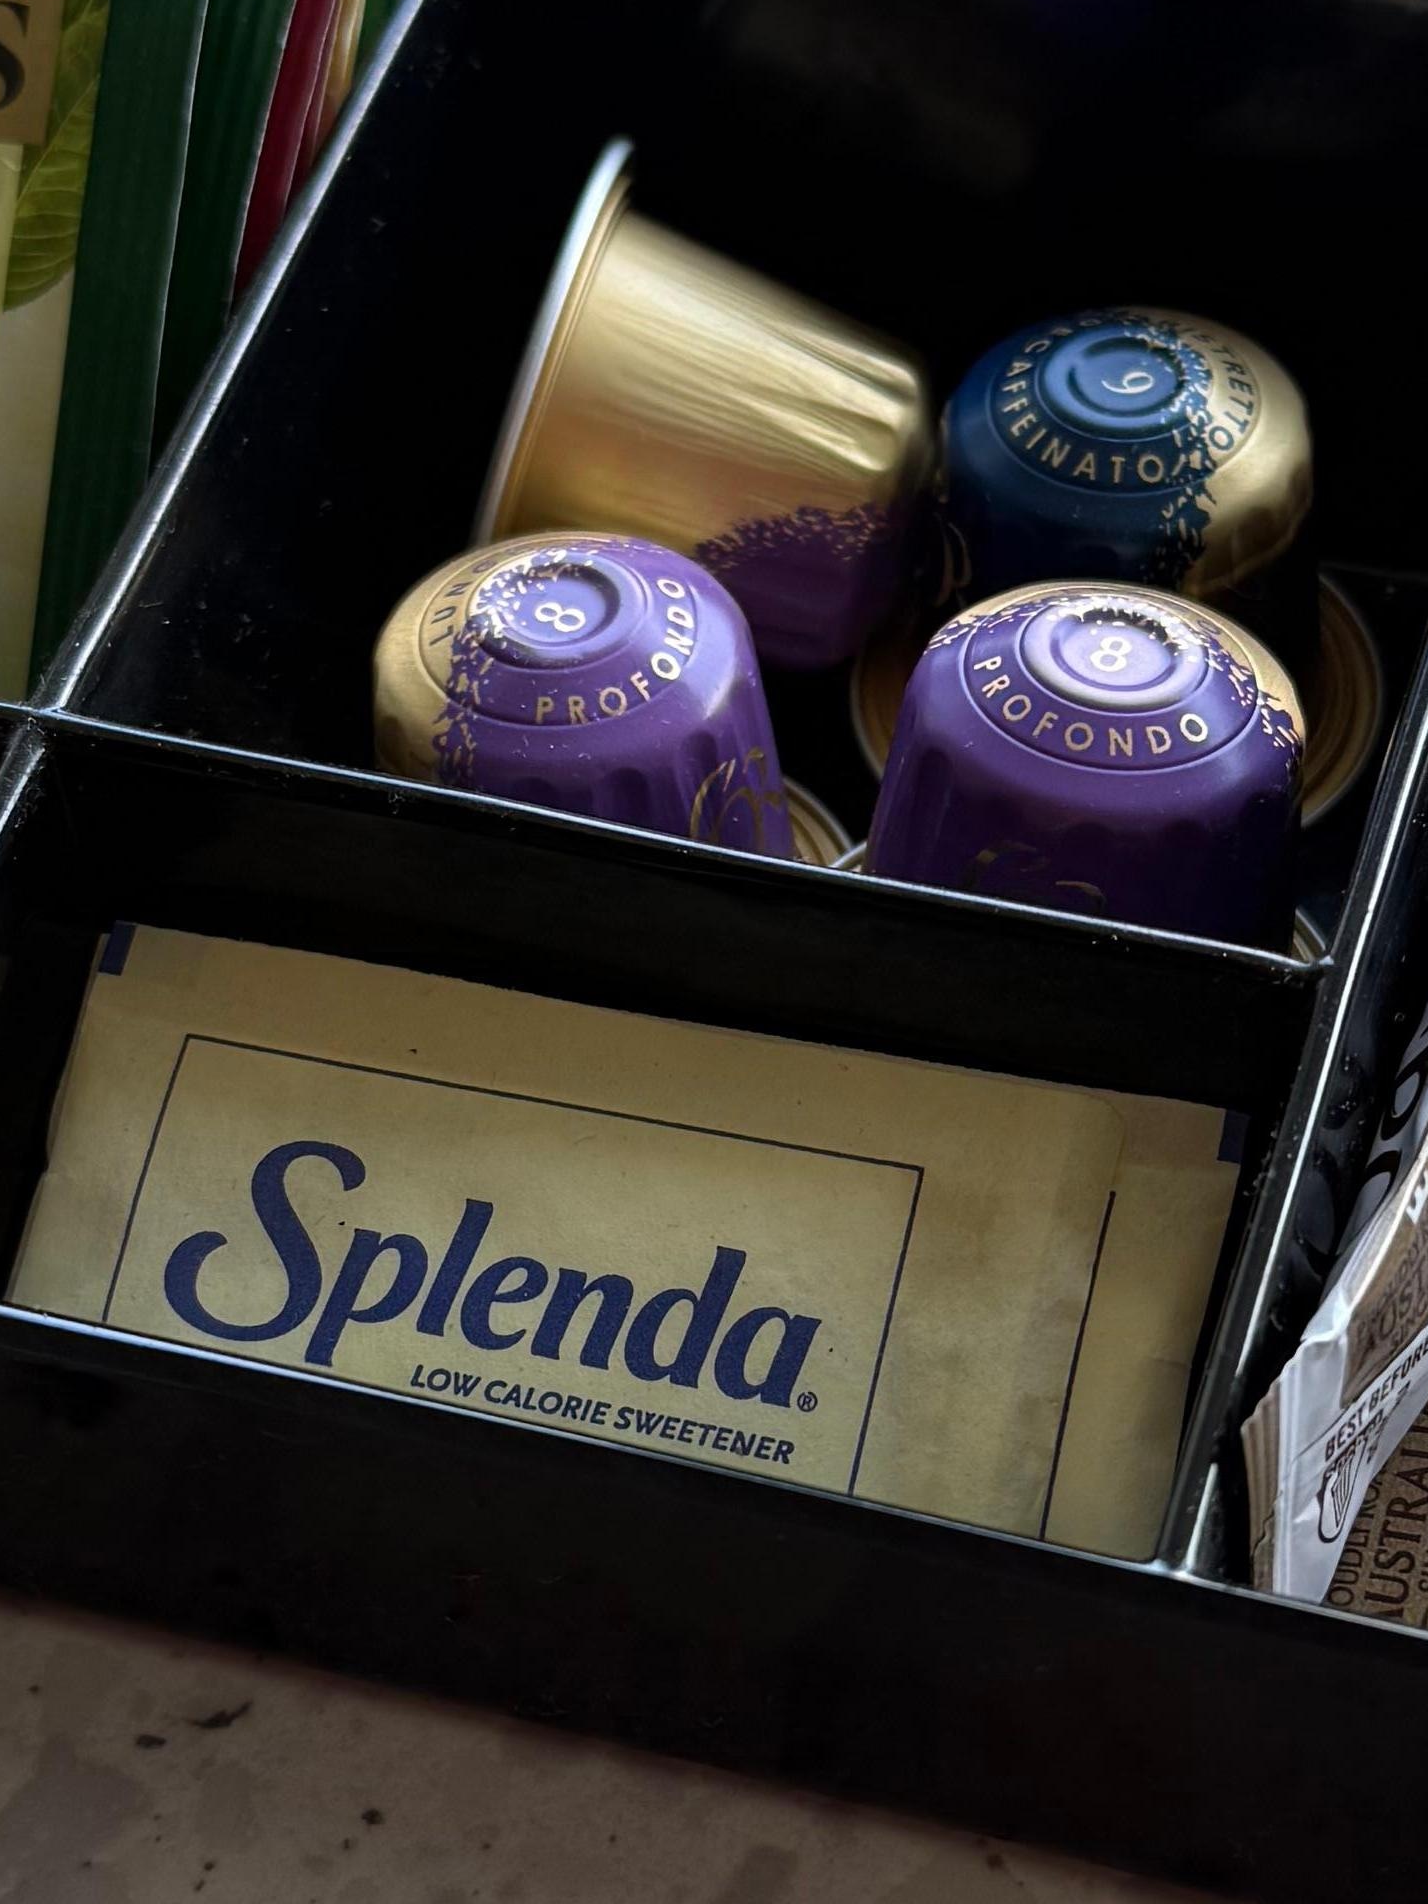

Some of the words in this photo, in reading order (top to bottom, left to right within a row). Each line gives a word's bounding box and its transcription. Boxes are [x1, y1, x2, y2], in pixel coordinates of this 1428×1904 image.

[533, 601, 587, 634] 8
[534, 577, 696, 726] PROFONDO
[1088, 635, 1134, 673] 8
[972, 655, 1211, 759] PROFONDO
[408, 1364, 484, 1394] LOW
[483, 1378, 610, 1430] CALORIE
[613, 1405, 797, 1466] SWEETENER
[1324, 1399, 1366, 1460] BEST
